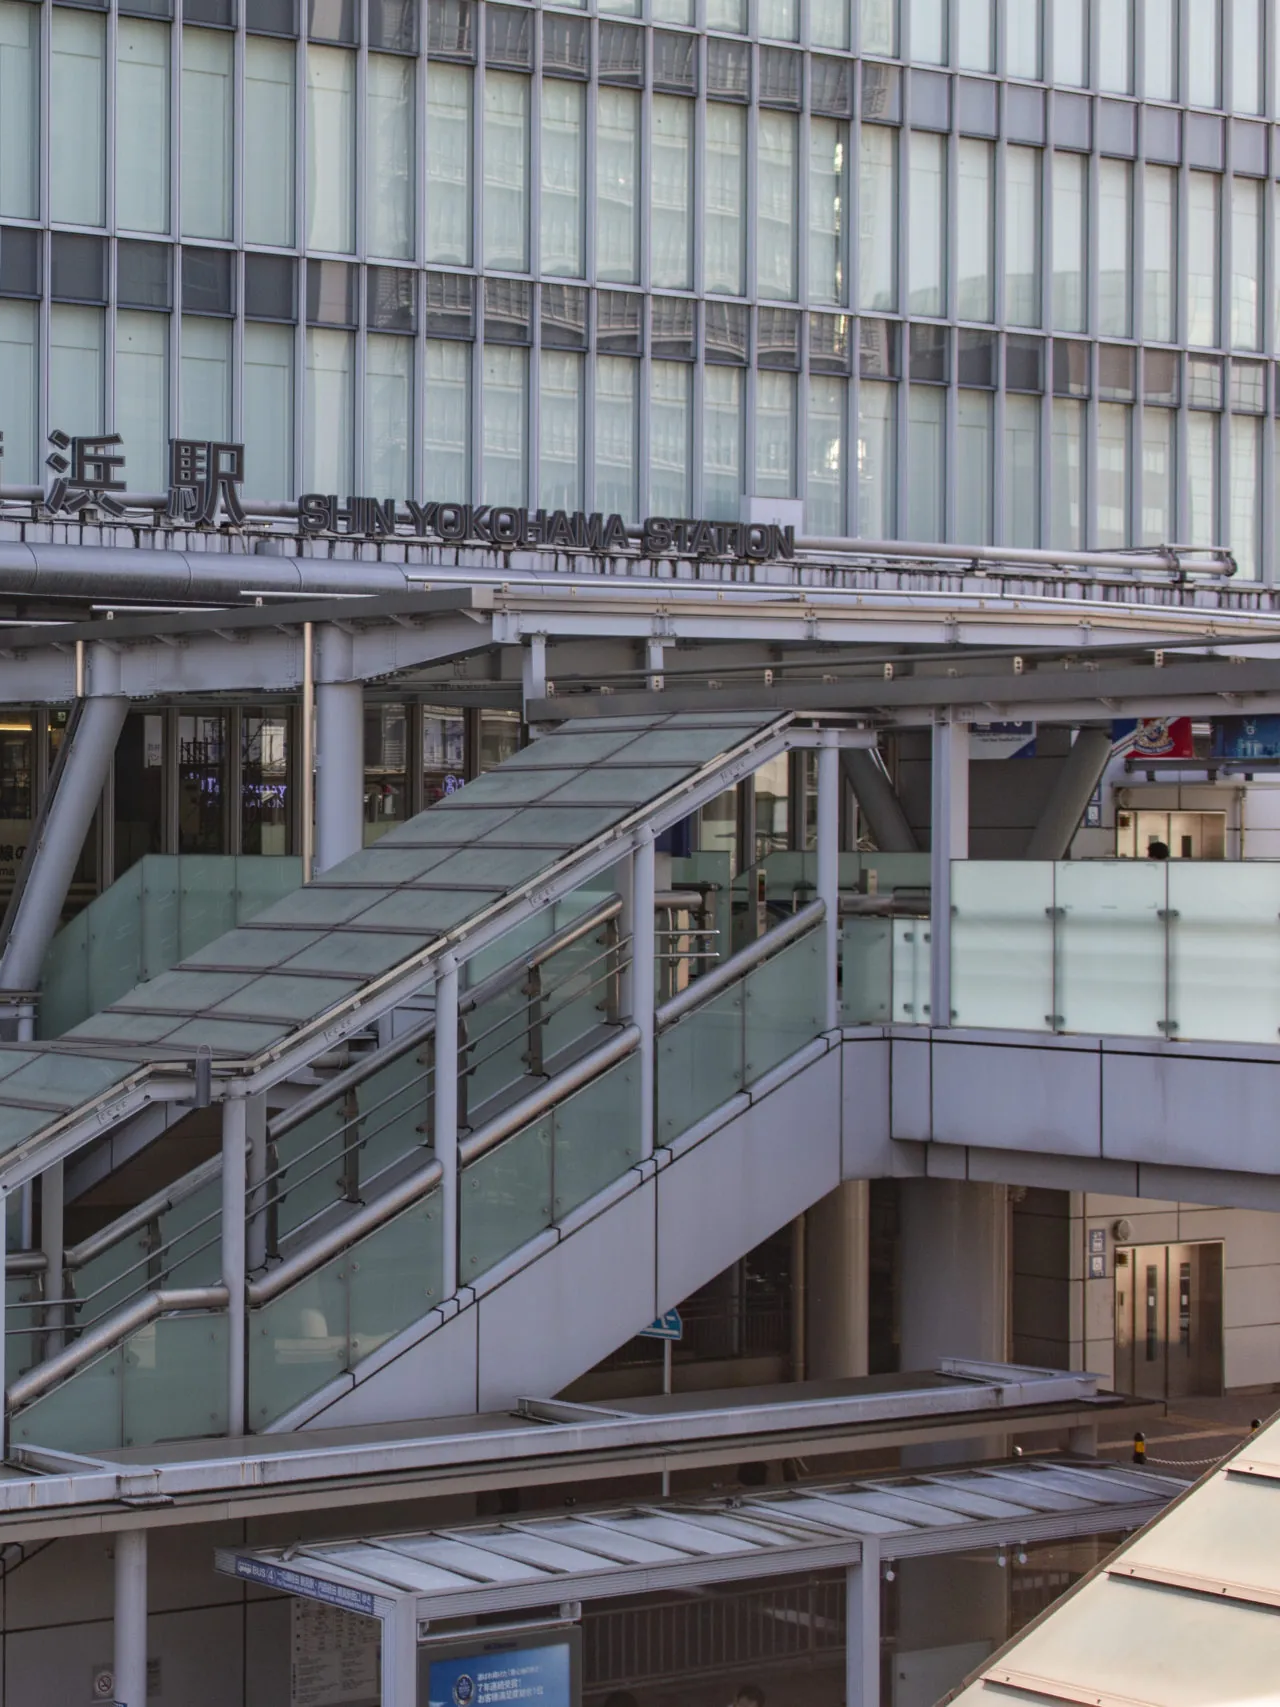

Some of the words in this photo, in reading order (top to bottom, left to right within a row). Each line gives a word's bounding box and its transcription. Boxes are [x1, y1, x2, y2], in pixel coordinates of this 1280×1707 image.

[298, 493, 630, 549] SHIN-YOKOHAMA
[643, 516, 796, 559] STATION
[251, 1565, 266, 1578] BUS
